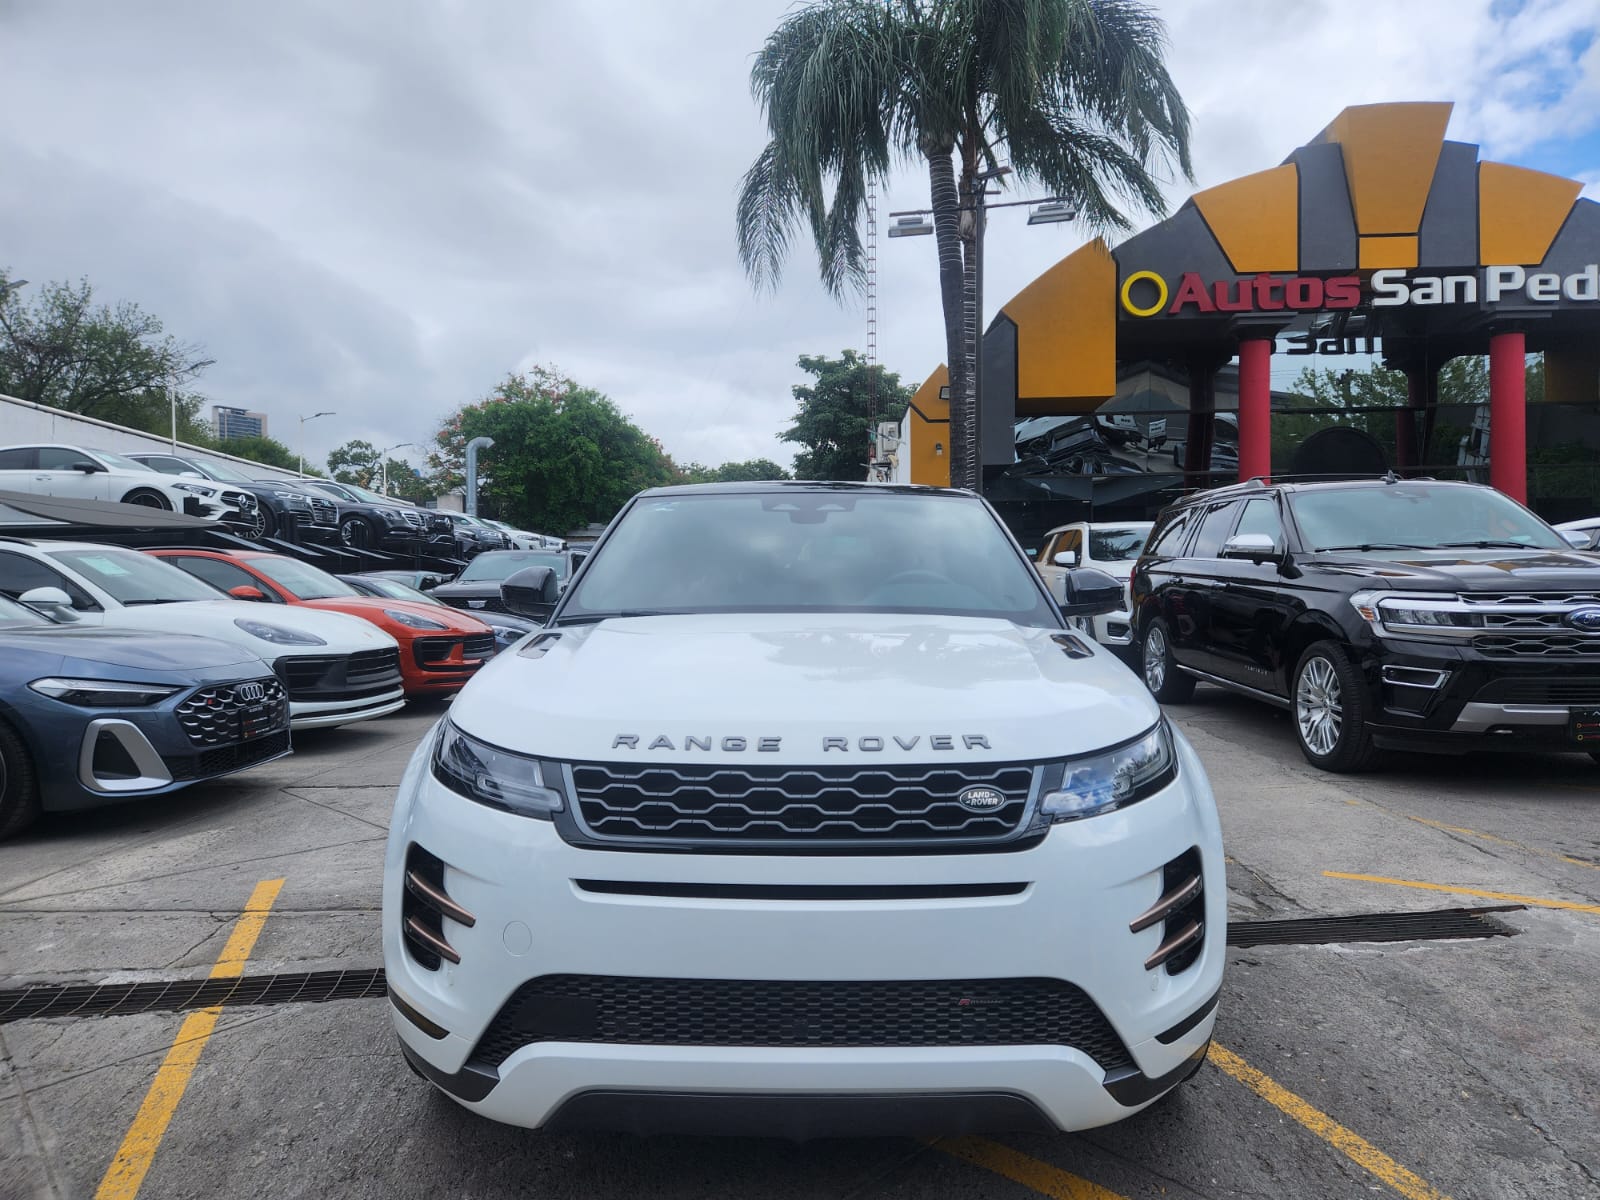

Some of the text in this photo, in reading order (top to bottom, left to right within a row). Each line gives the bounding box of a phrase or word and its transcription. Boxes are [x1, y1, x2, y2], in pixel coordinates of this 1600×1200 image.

[1168, 271, 1361, 314] Autos
[1486, 264, 1600, 303] Ped
[612, 733, 993, 753] RANGE ROVER
[967, 791, 990, 799] LAND
[970, 798, 998, 806] ROVER
